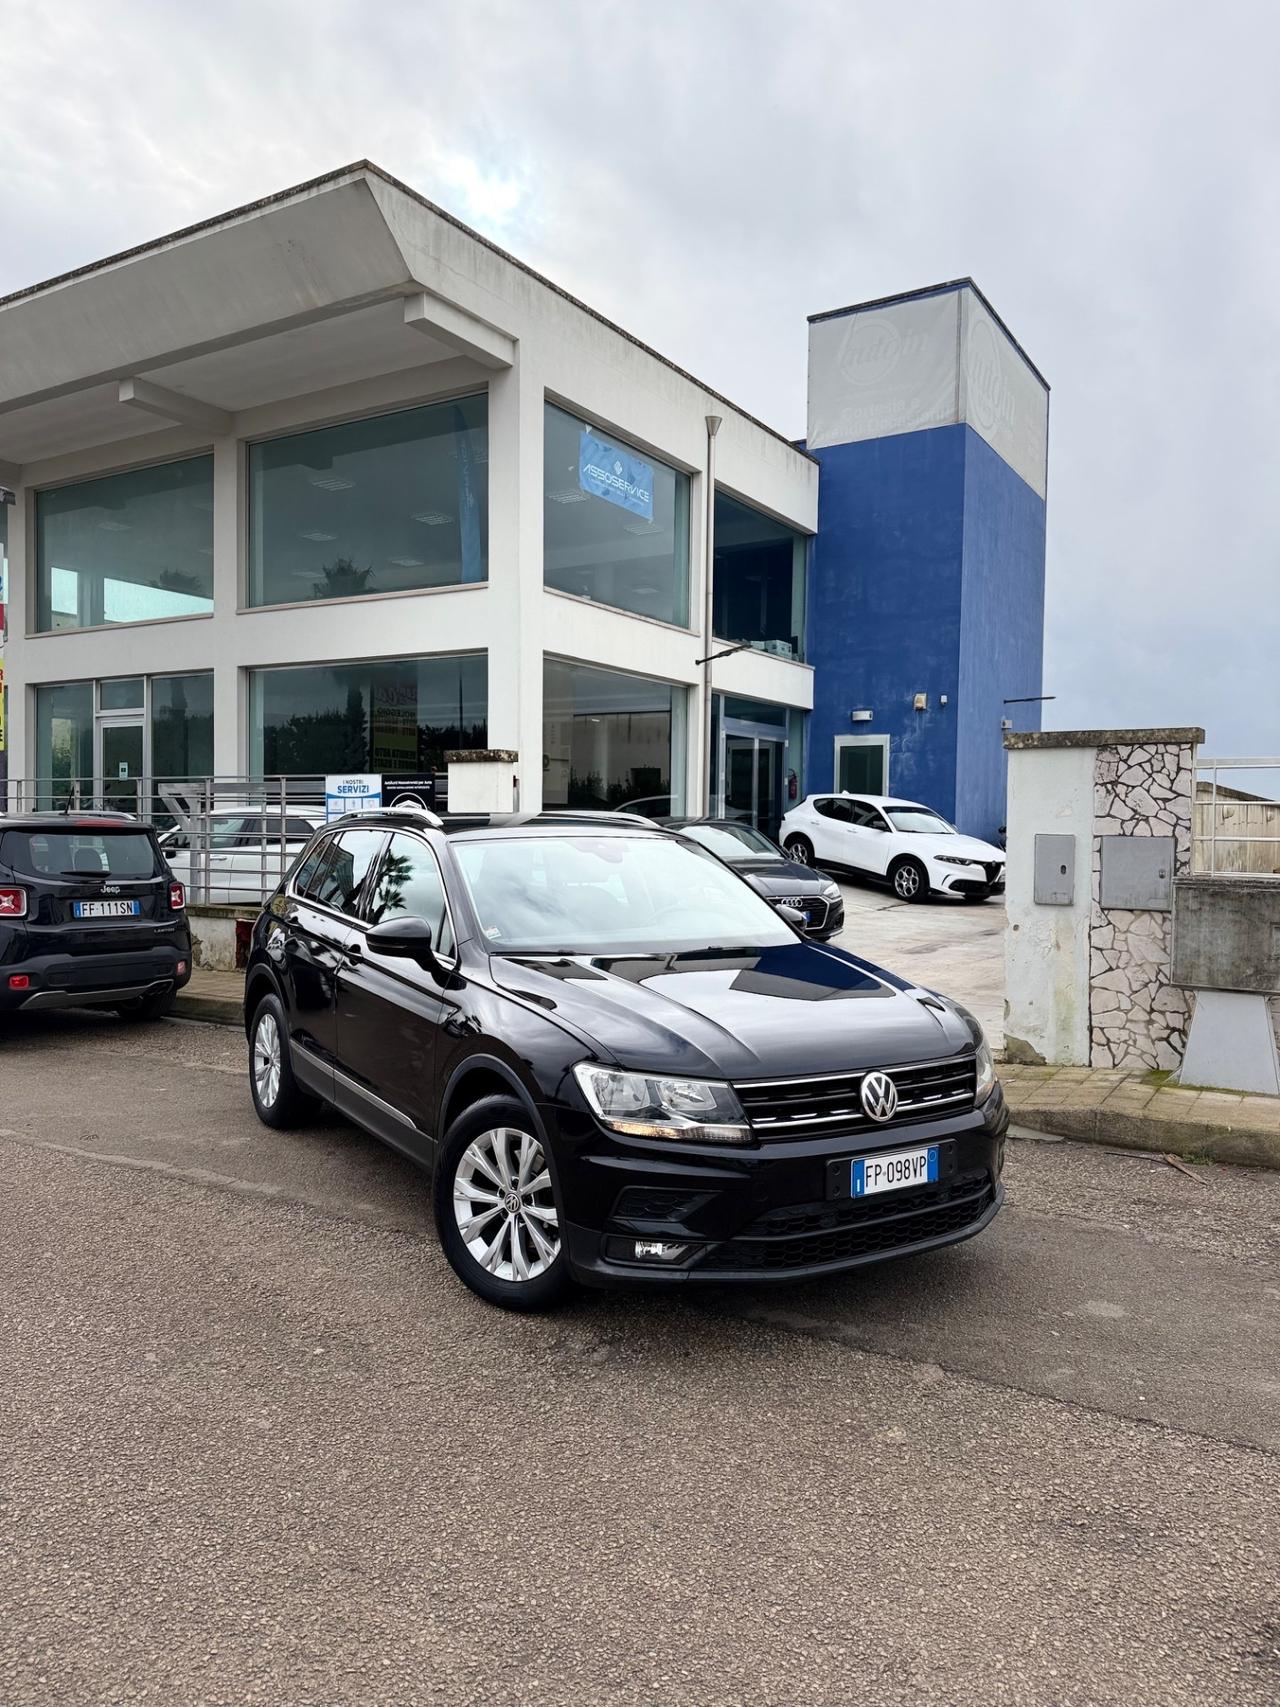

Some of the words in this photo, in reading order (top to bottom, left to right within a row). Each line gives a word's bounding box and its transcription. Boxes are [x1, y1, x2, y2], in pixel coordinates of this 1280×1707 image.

[583, 463, 650, 503] ASSOSERVICE
[337, 785, 370, 794] SERVIZI
[100, 885, 121, 894] Jeep
[865, 1164, 882, 1188] FP
[887, 1155, 927, 1183] 098VP
